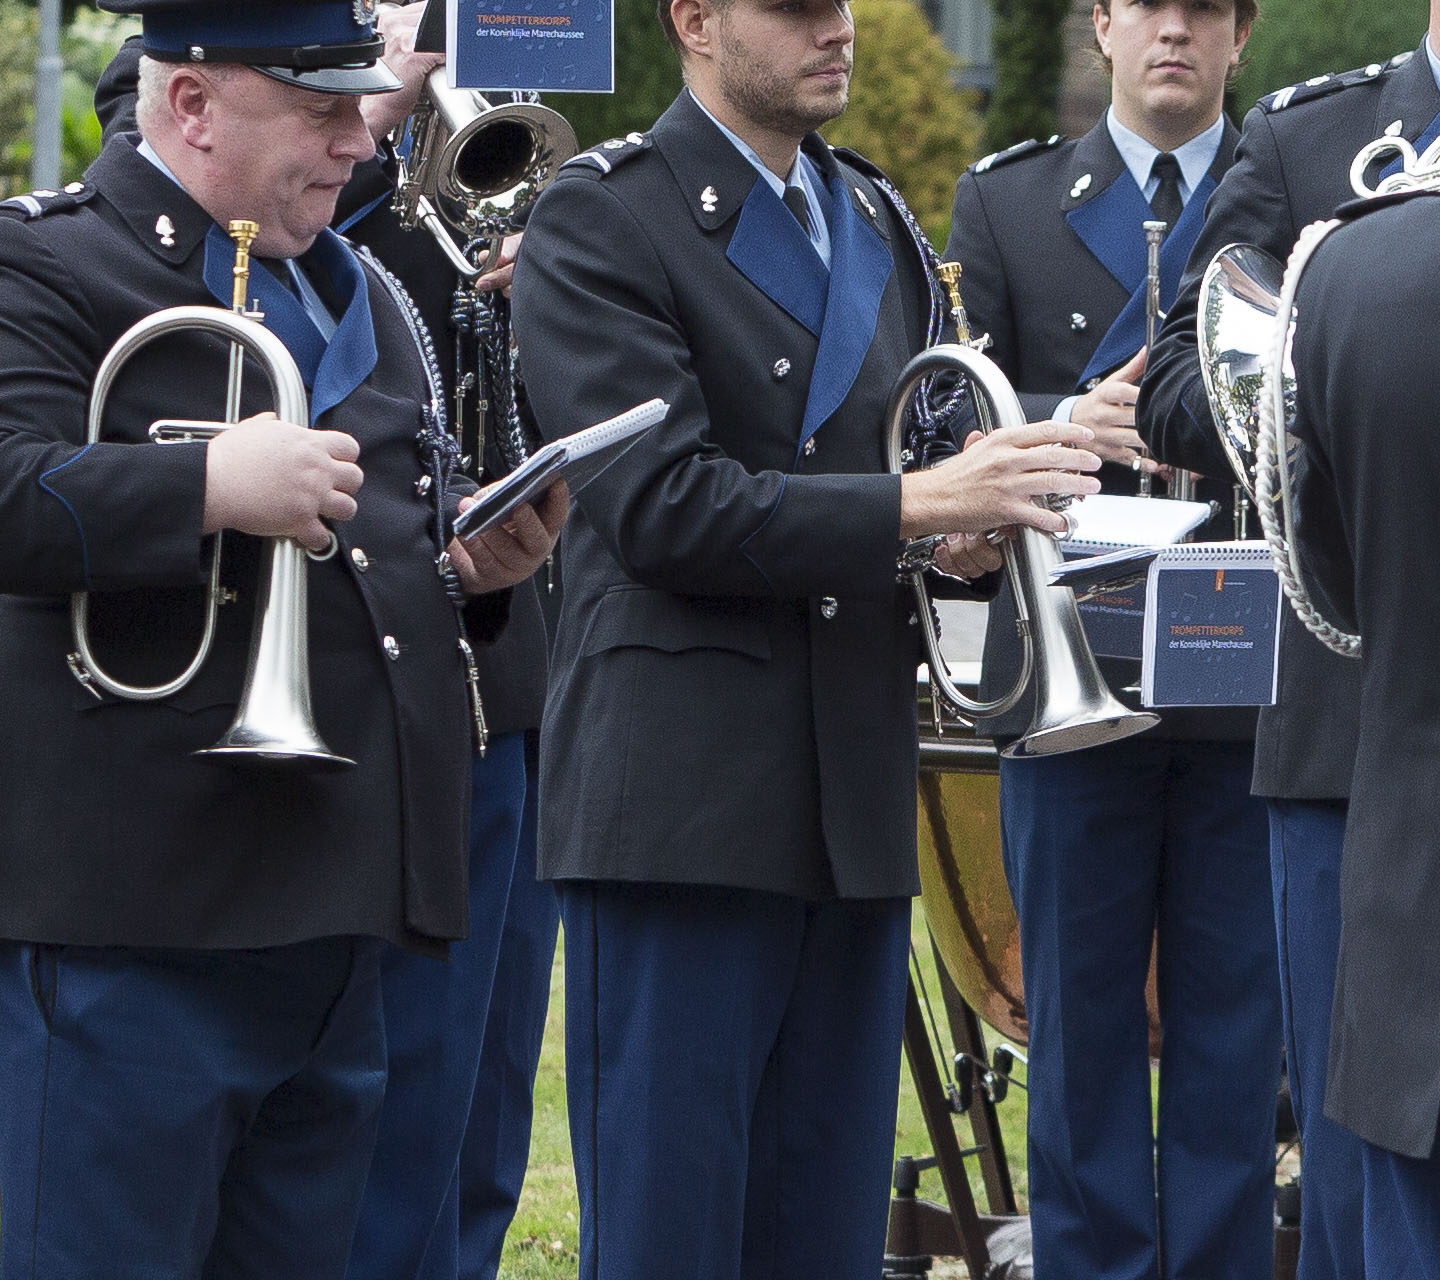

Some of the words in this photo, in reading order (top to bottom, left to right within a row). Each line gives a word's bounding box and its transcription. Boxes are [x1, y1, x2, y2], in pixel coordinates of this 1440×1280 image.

[476, 14, 571, 26] TROMPETTERKORPS
[476, 28, 489, 37] der
[490, 28, 530, 39] Koninklijke
[531, 29, 585, 39] Marechaussee
[1170, 625, 1245, 636] TROMPETTERKORPS
[1169, 639, 1180, 649] der
[1180, 639, 1211, 651] Koninklijke
[1211, 639, 1254, 649] Marechaussee
